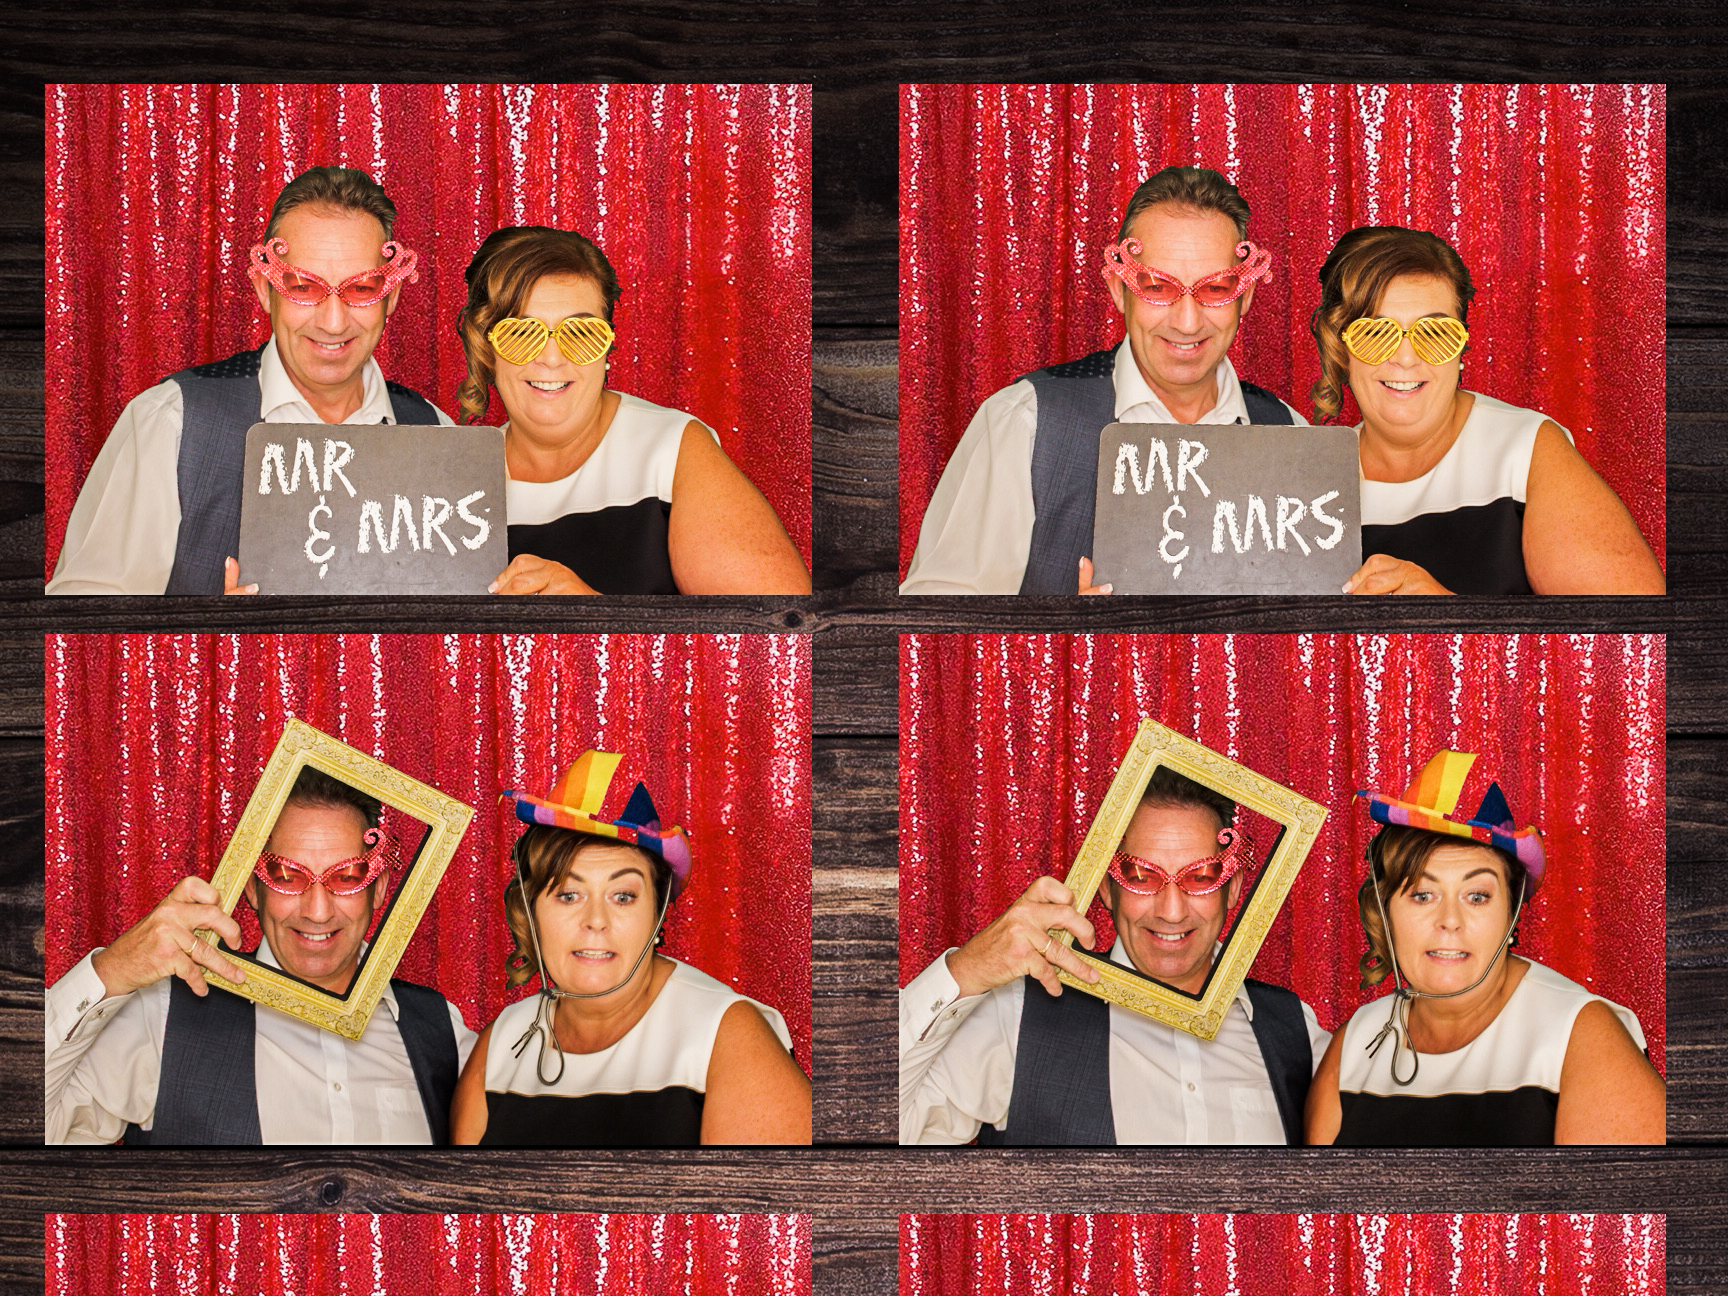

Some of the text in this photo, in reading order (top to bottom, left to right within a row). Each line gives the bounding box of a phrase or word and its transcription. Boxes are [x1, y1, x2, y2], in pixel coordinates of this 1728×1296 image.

[258, 437, 357, 498] MR
[1112, 437, 1211, 498] MR
[303, 490, 492, 579] & MRS
[1157, 490, 1346, 579] & MRS
